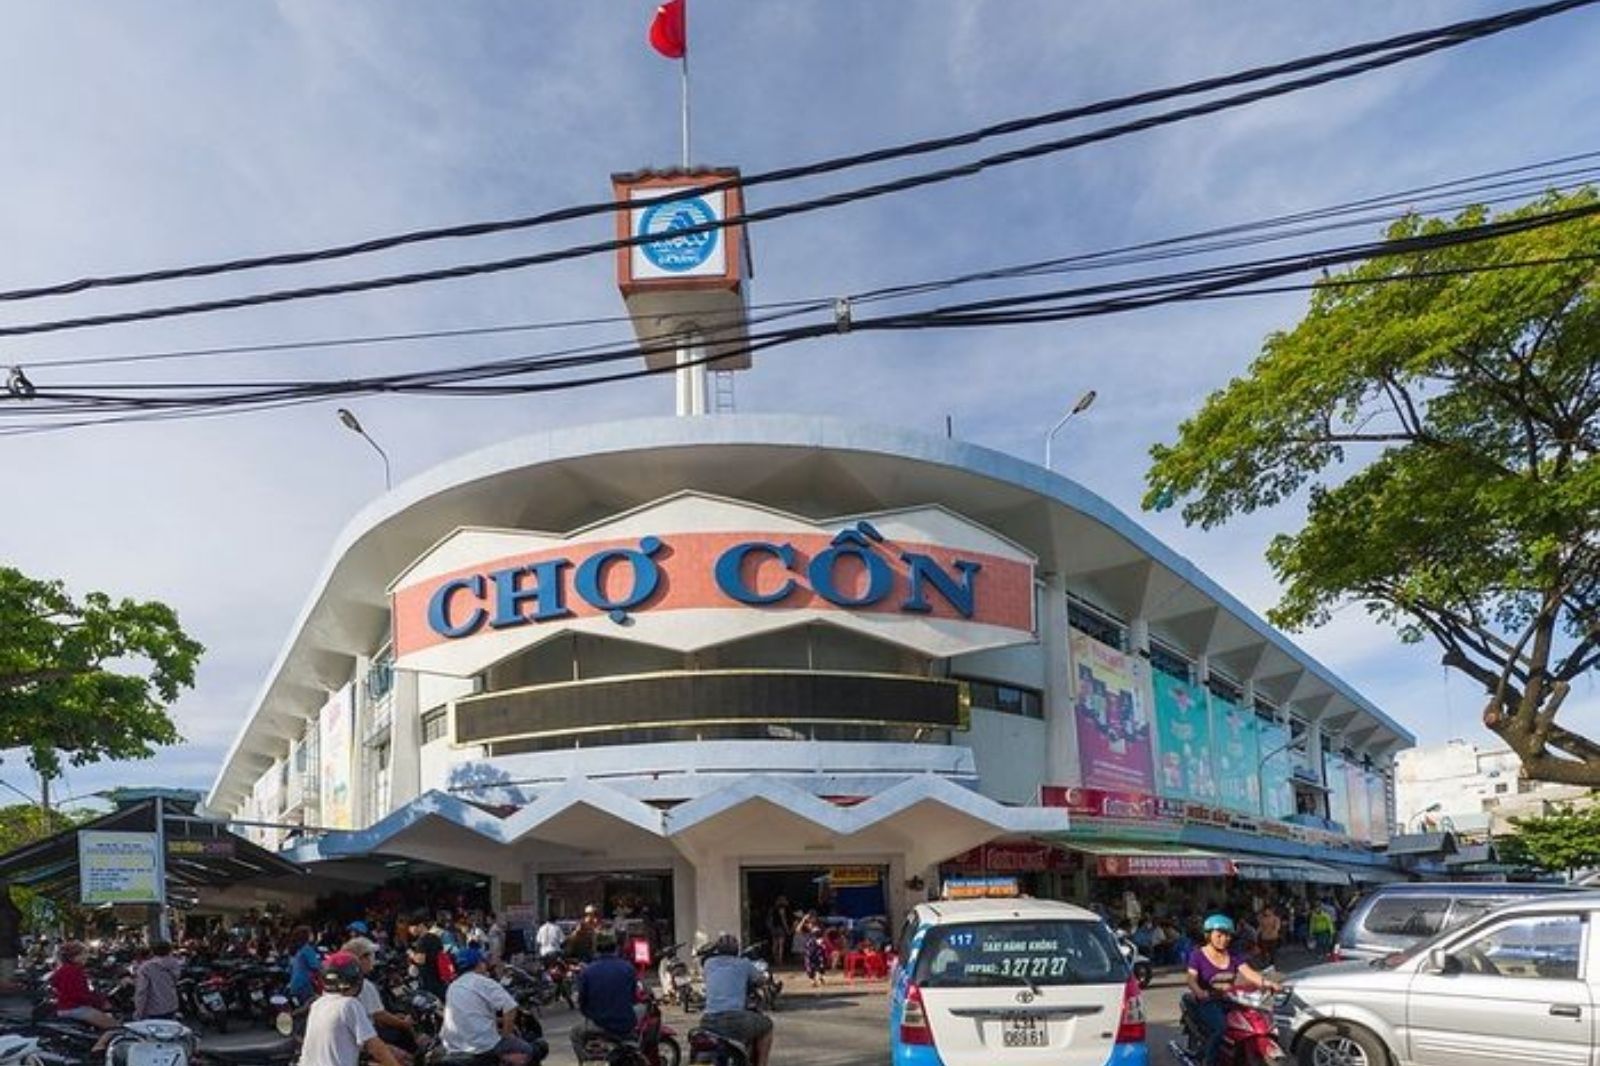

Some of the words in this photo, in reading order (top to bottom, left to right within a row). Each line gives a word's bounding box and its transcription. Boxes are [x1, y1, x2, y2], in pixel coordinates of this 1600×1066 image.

[428, 534, 662, 638] CHỢ
[714, 520, 982, 618] CỒN
[949, 934, 973, 946] 117
[1001, 957, 1011, 976] 3
[1012, 957, 1029, 977] 27
[1031, 957, 1049, 977] 27
[1050, 956, 1068, 977] 27
